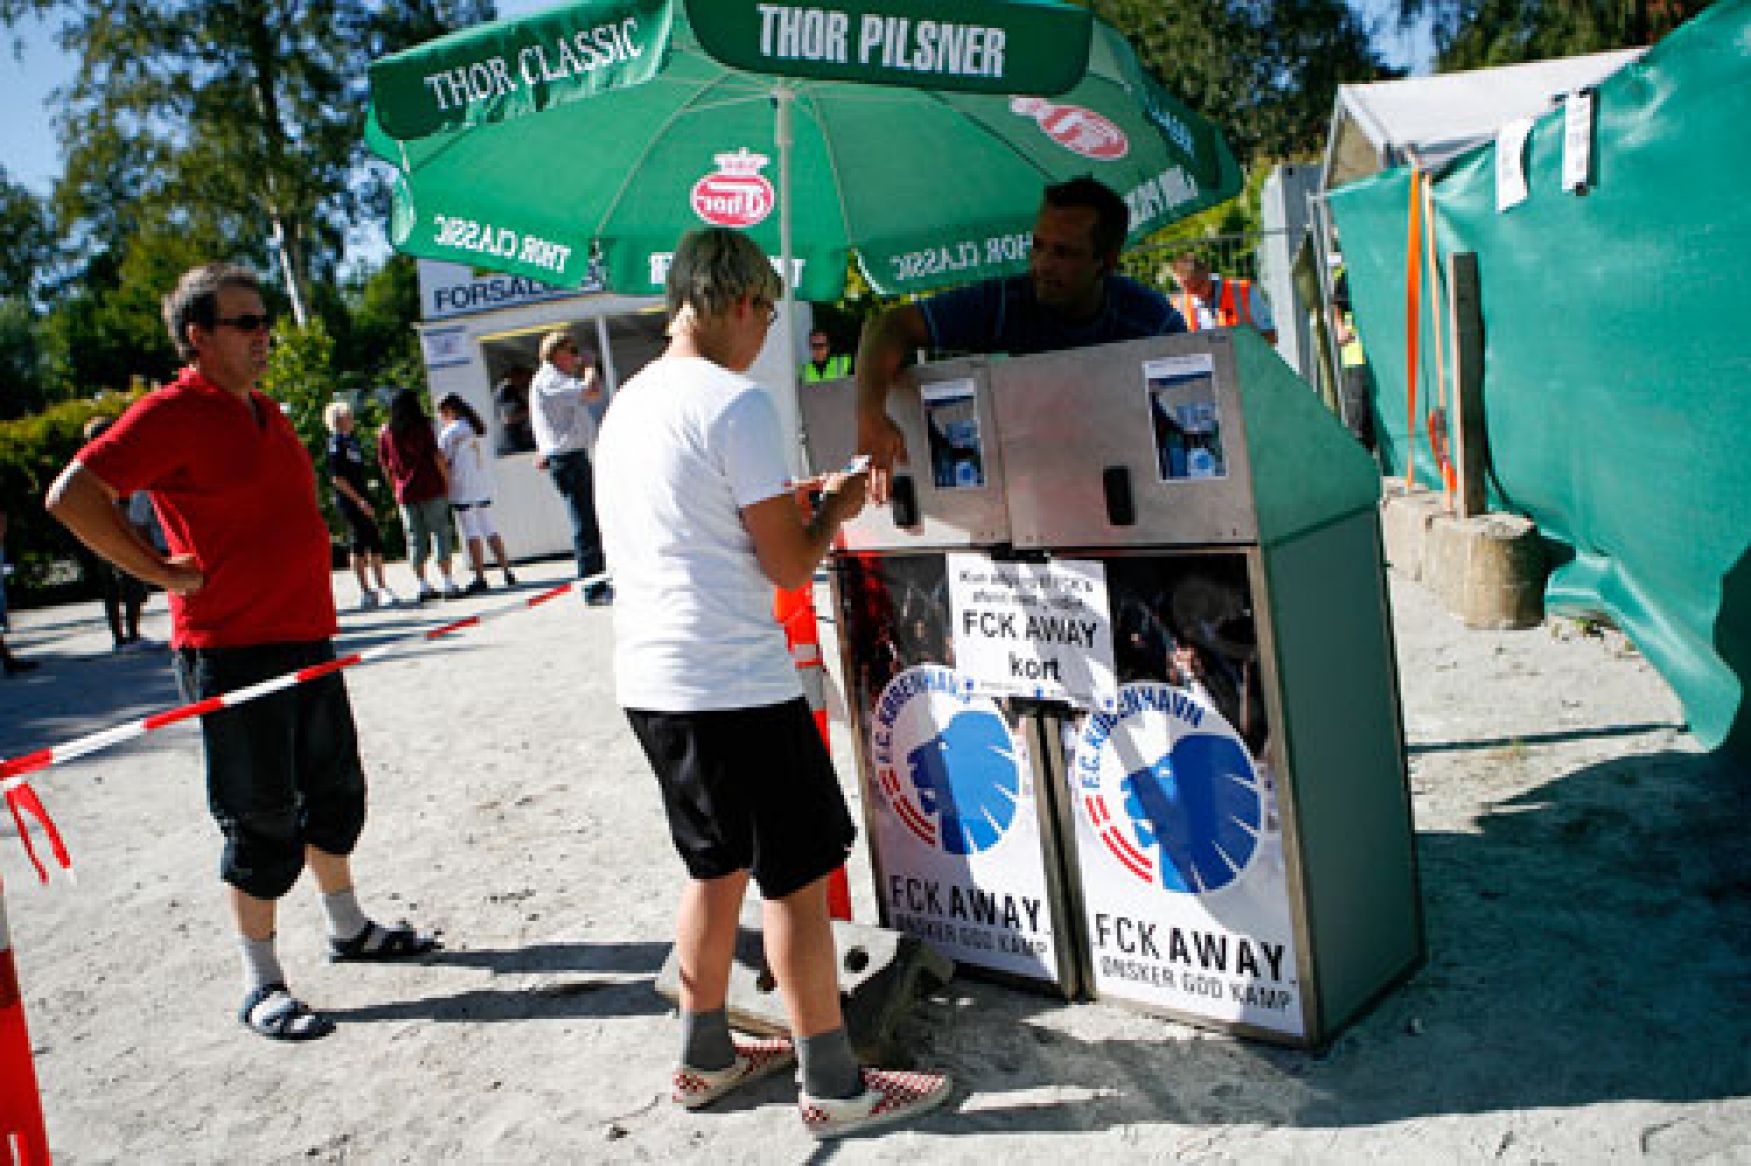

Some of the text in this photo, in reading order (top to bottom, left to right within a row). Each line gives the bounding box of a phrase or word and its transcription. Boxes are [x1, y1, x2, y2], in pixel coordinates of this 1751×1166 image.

[424, 17, 645, 110] THOR CLASSIC
[756, 3, 1006, 77] THOR PILSNER
[963, 609, 1096, 648] FCK AWAY
[890, 875, 941, 916] FCK
[1096, 913, 1160, 960] FCK
